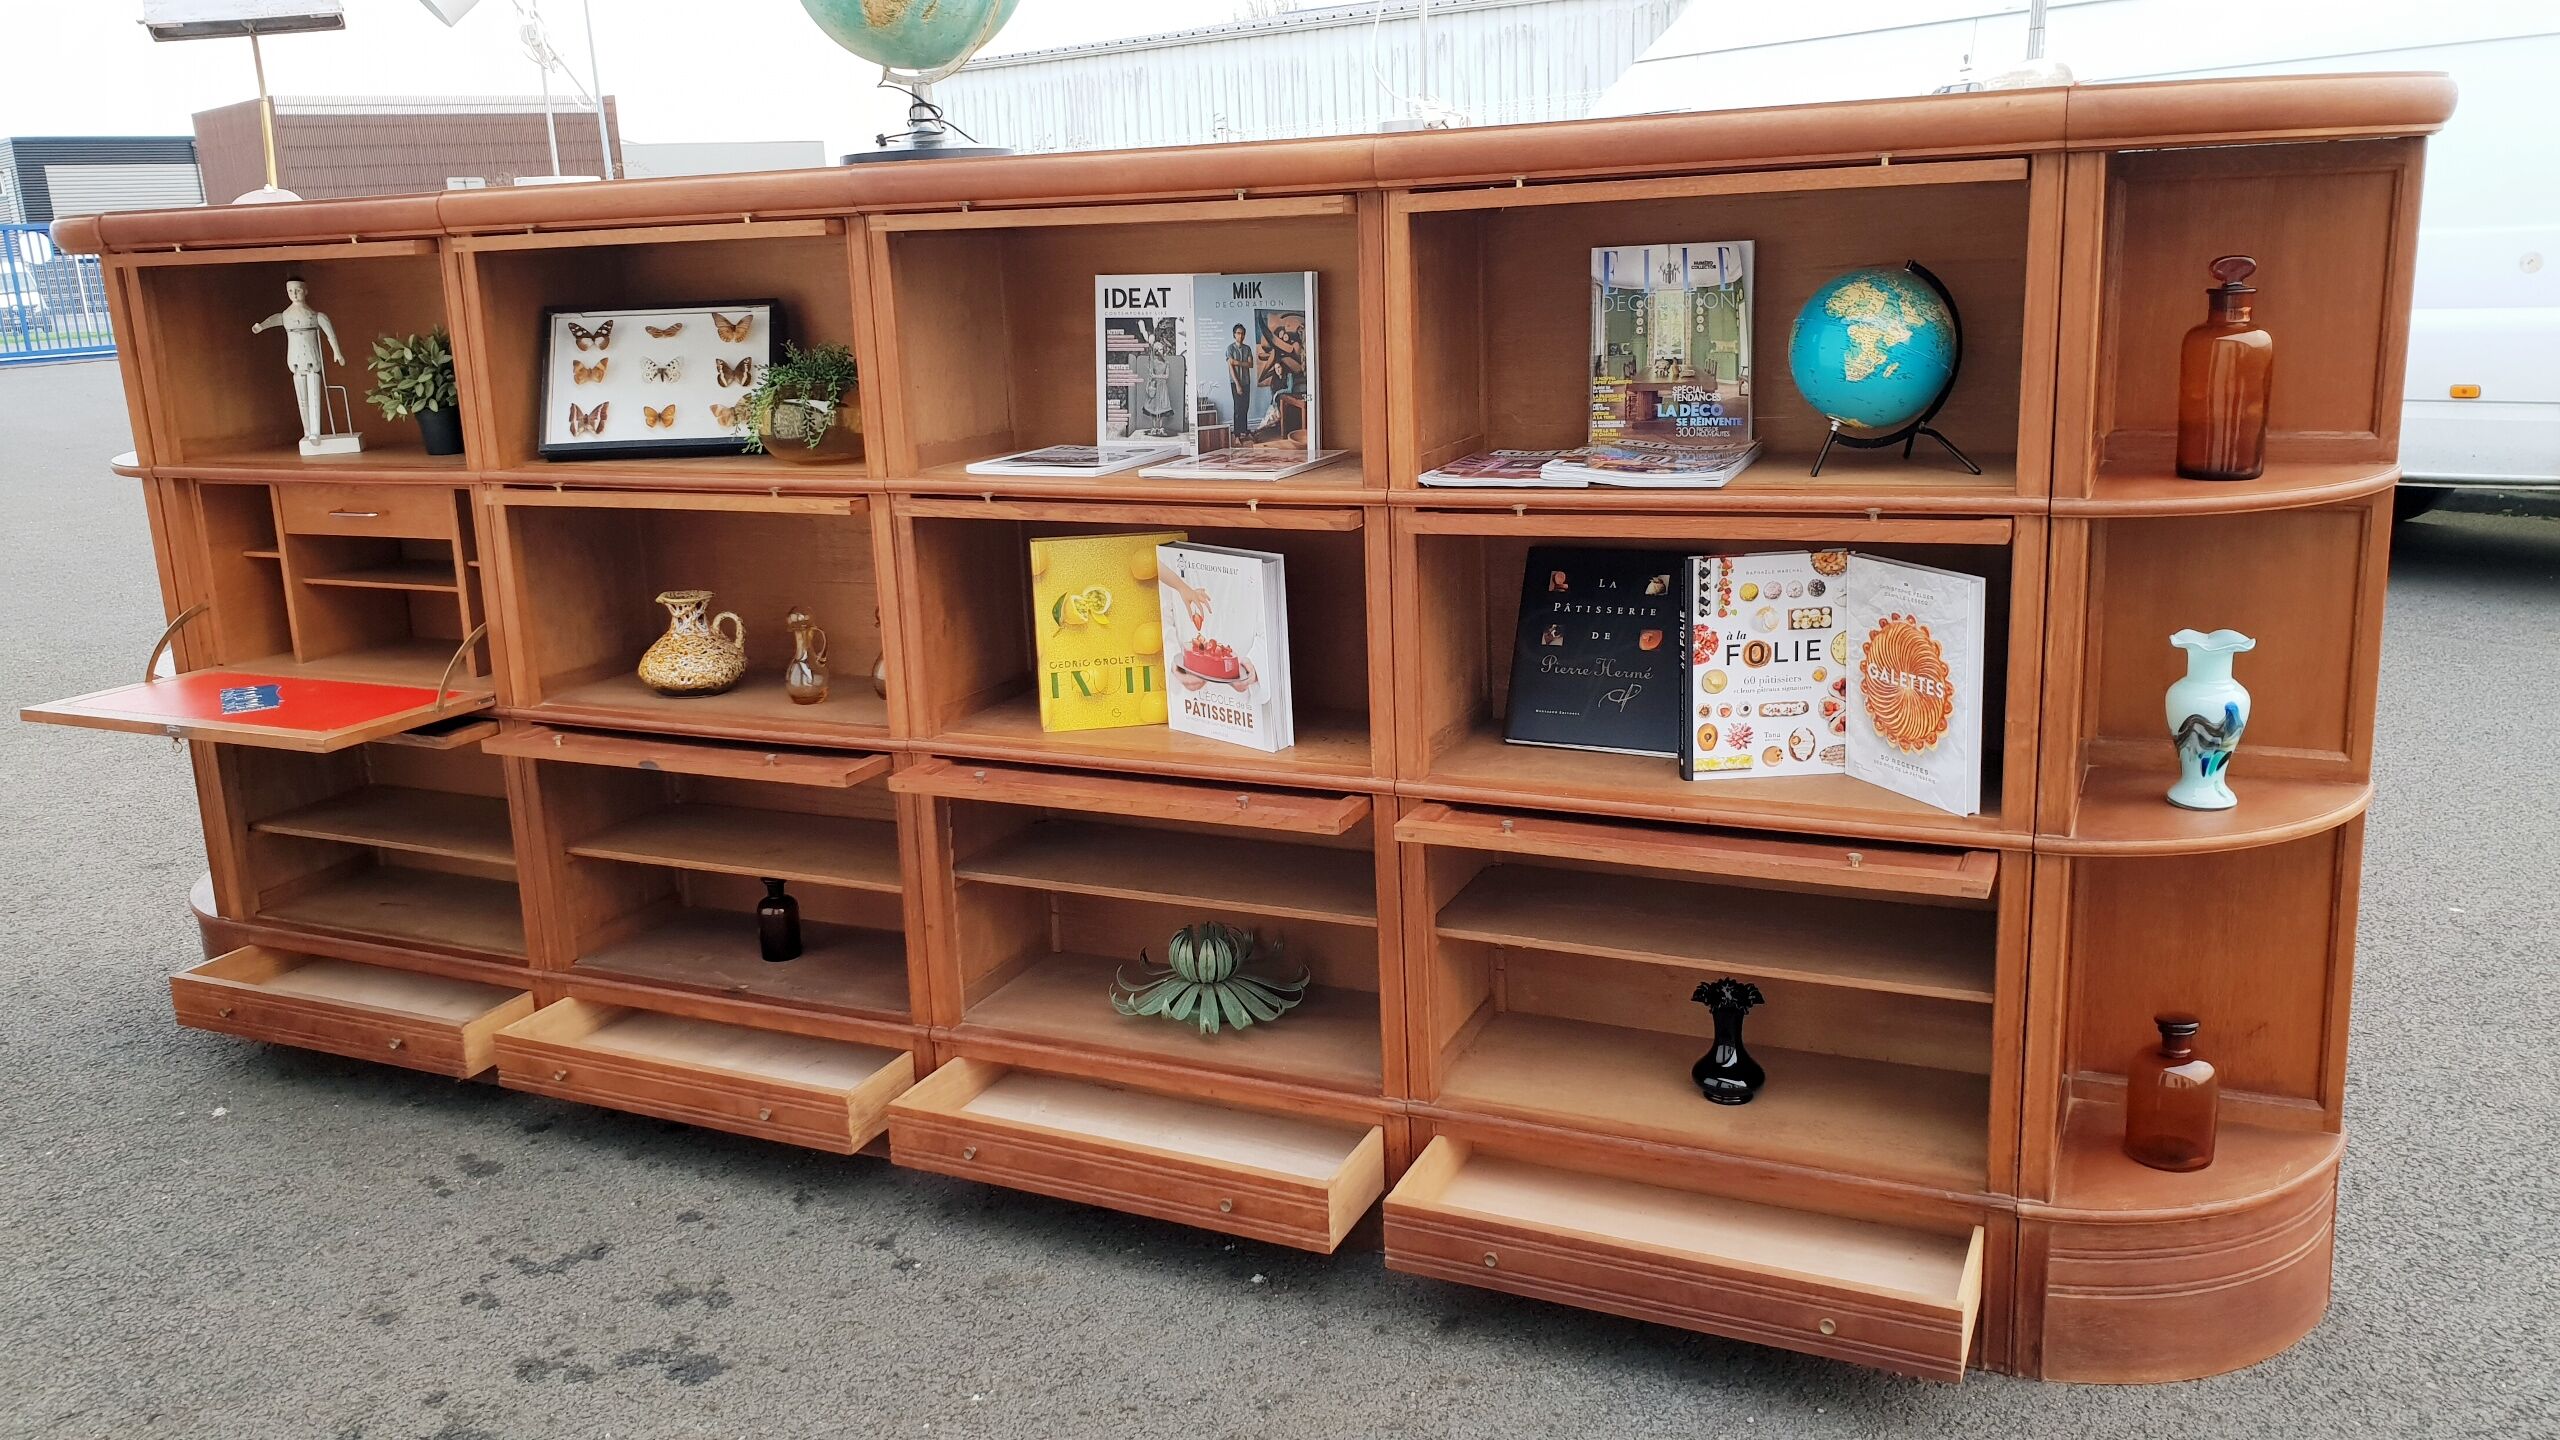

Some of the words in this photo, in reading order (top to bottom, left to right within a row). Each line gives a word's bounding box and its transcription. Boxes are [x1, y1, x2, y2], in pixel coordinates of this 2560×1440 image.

[1601, 247, 1735, 295] ELLE
[1104, 287, 1171, 309] IDEAT
[1215, 300, 1284, 309] DECORATION
[1603, 291, 1736, 313] DECOTION
[1672, 393, 1721, 402] TENDANCES
[1657, 403, 1677, 418] LA
[1680, 402, 1723, 417] DÉCO
[1676, 417, 1688, 426] SE
[1690, 416, 1744, 426] RÉINVENTE
[1675, 427, 1696, 437] 300
[1195, 562, 1222, 573] CORDON
[1599, 579, 1617, 589] LA
[1553, 602, 1657, 616] PÂTISSERIE
[1591, 631, 1611, 640] DE
[1678, 610, 1686, 647] FOLIE
[1726, 631, 1733, 640] à
[1736, 630, 1747, 640] la
[1726, 639, 1821, 666] FOLIE
[1540, 654, 1591, 676] Pierre
[1594, 657, 1654, 679] Hermé
[1743, 675, 1756, 685] 60
[1758, 674, 1802, 687] pâtissiers
[1867, 662, 1945, 699] GALETTES
[1184, 697, 1254, 729] PÂTISSERIE
[1891, 758, 1929, 776] RECETTES
